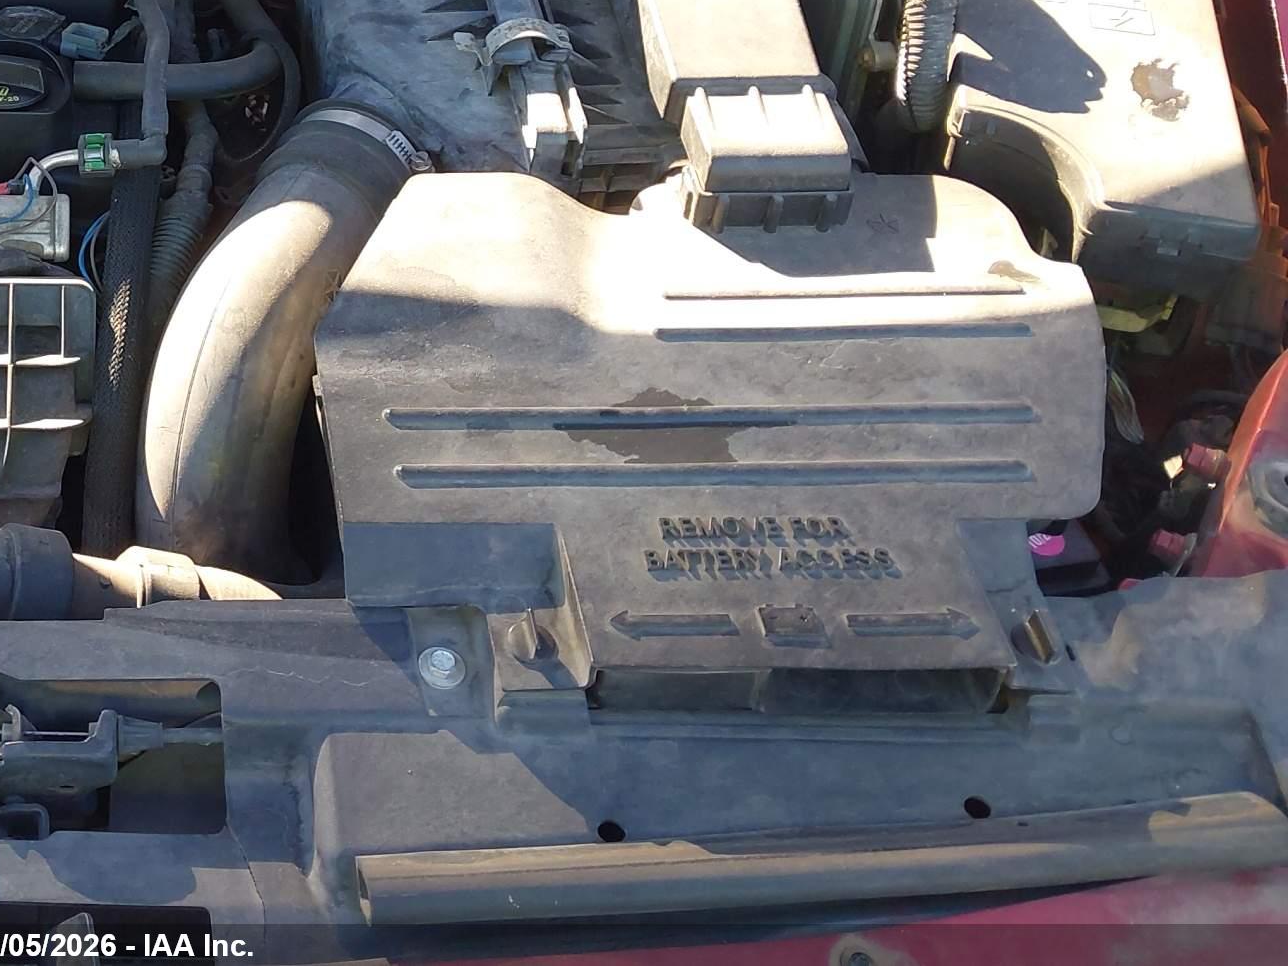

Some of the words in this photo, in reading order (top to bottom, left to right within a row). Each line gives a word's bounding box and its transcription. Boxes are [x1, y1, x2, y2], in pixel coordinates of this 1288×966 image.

[657, 516, 778, 541] REMOVE
[788, 516, 850, 541] FOR
[643, 547, 768, 573] BATTERY
[777, 547, 895, 573] ACCESS
